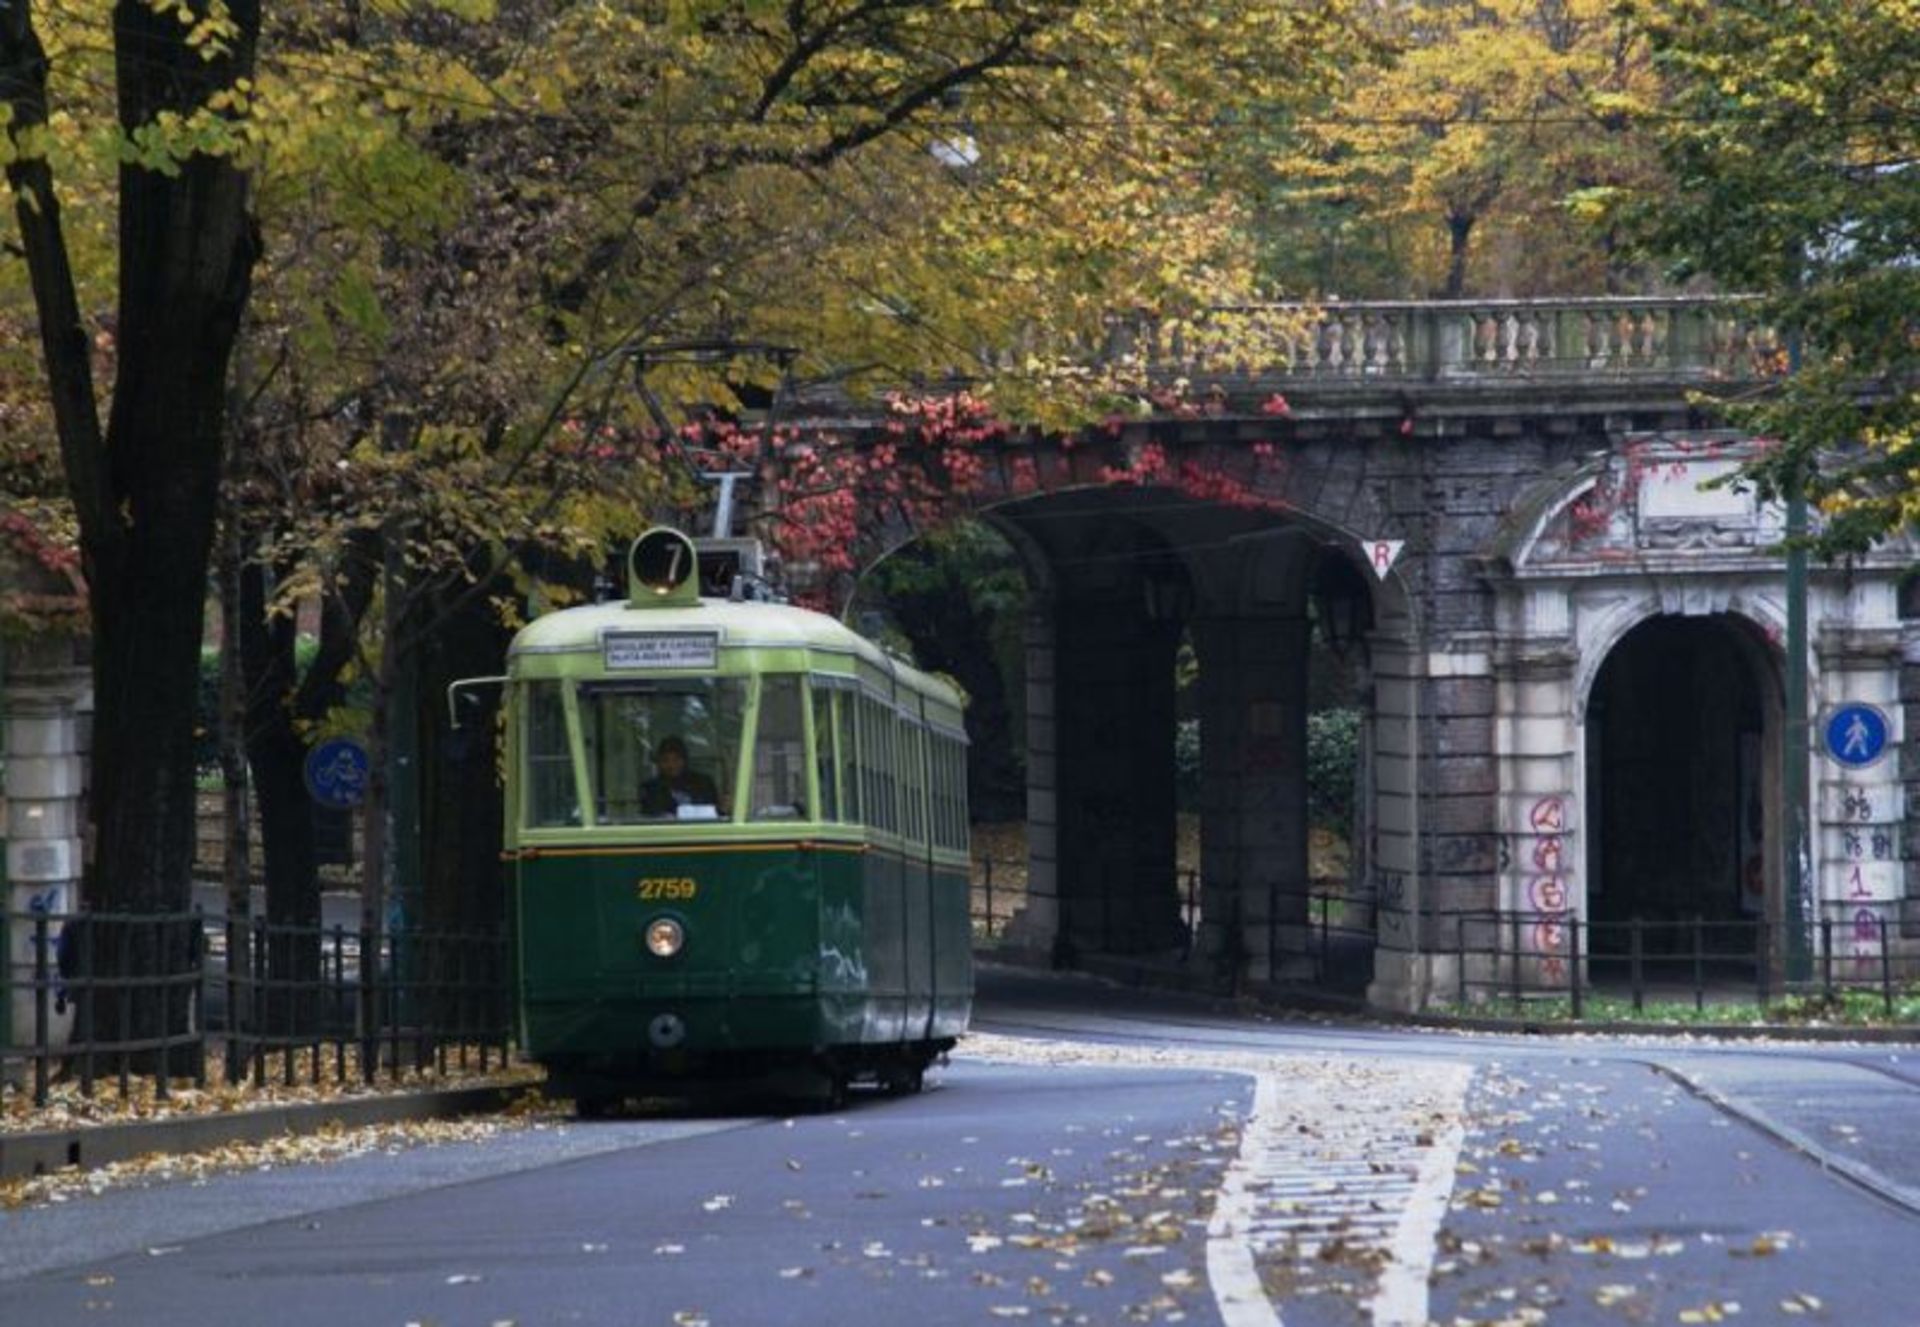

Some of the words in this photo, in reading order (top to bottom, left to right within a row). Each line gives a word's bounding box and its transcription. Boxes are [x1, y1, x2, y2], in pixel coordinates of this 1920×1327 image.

[665, 543, 683, 581] 7
[1374, 540, 1391, 567] R
[638, 877, 696, 899] 2759
